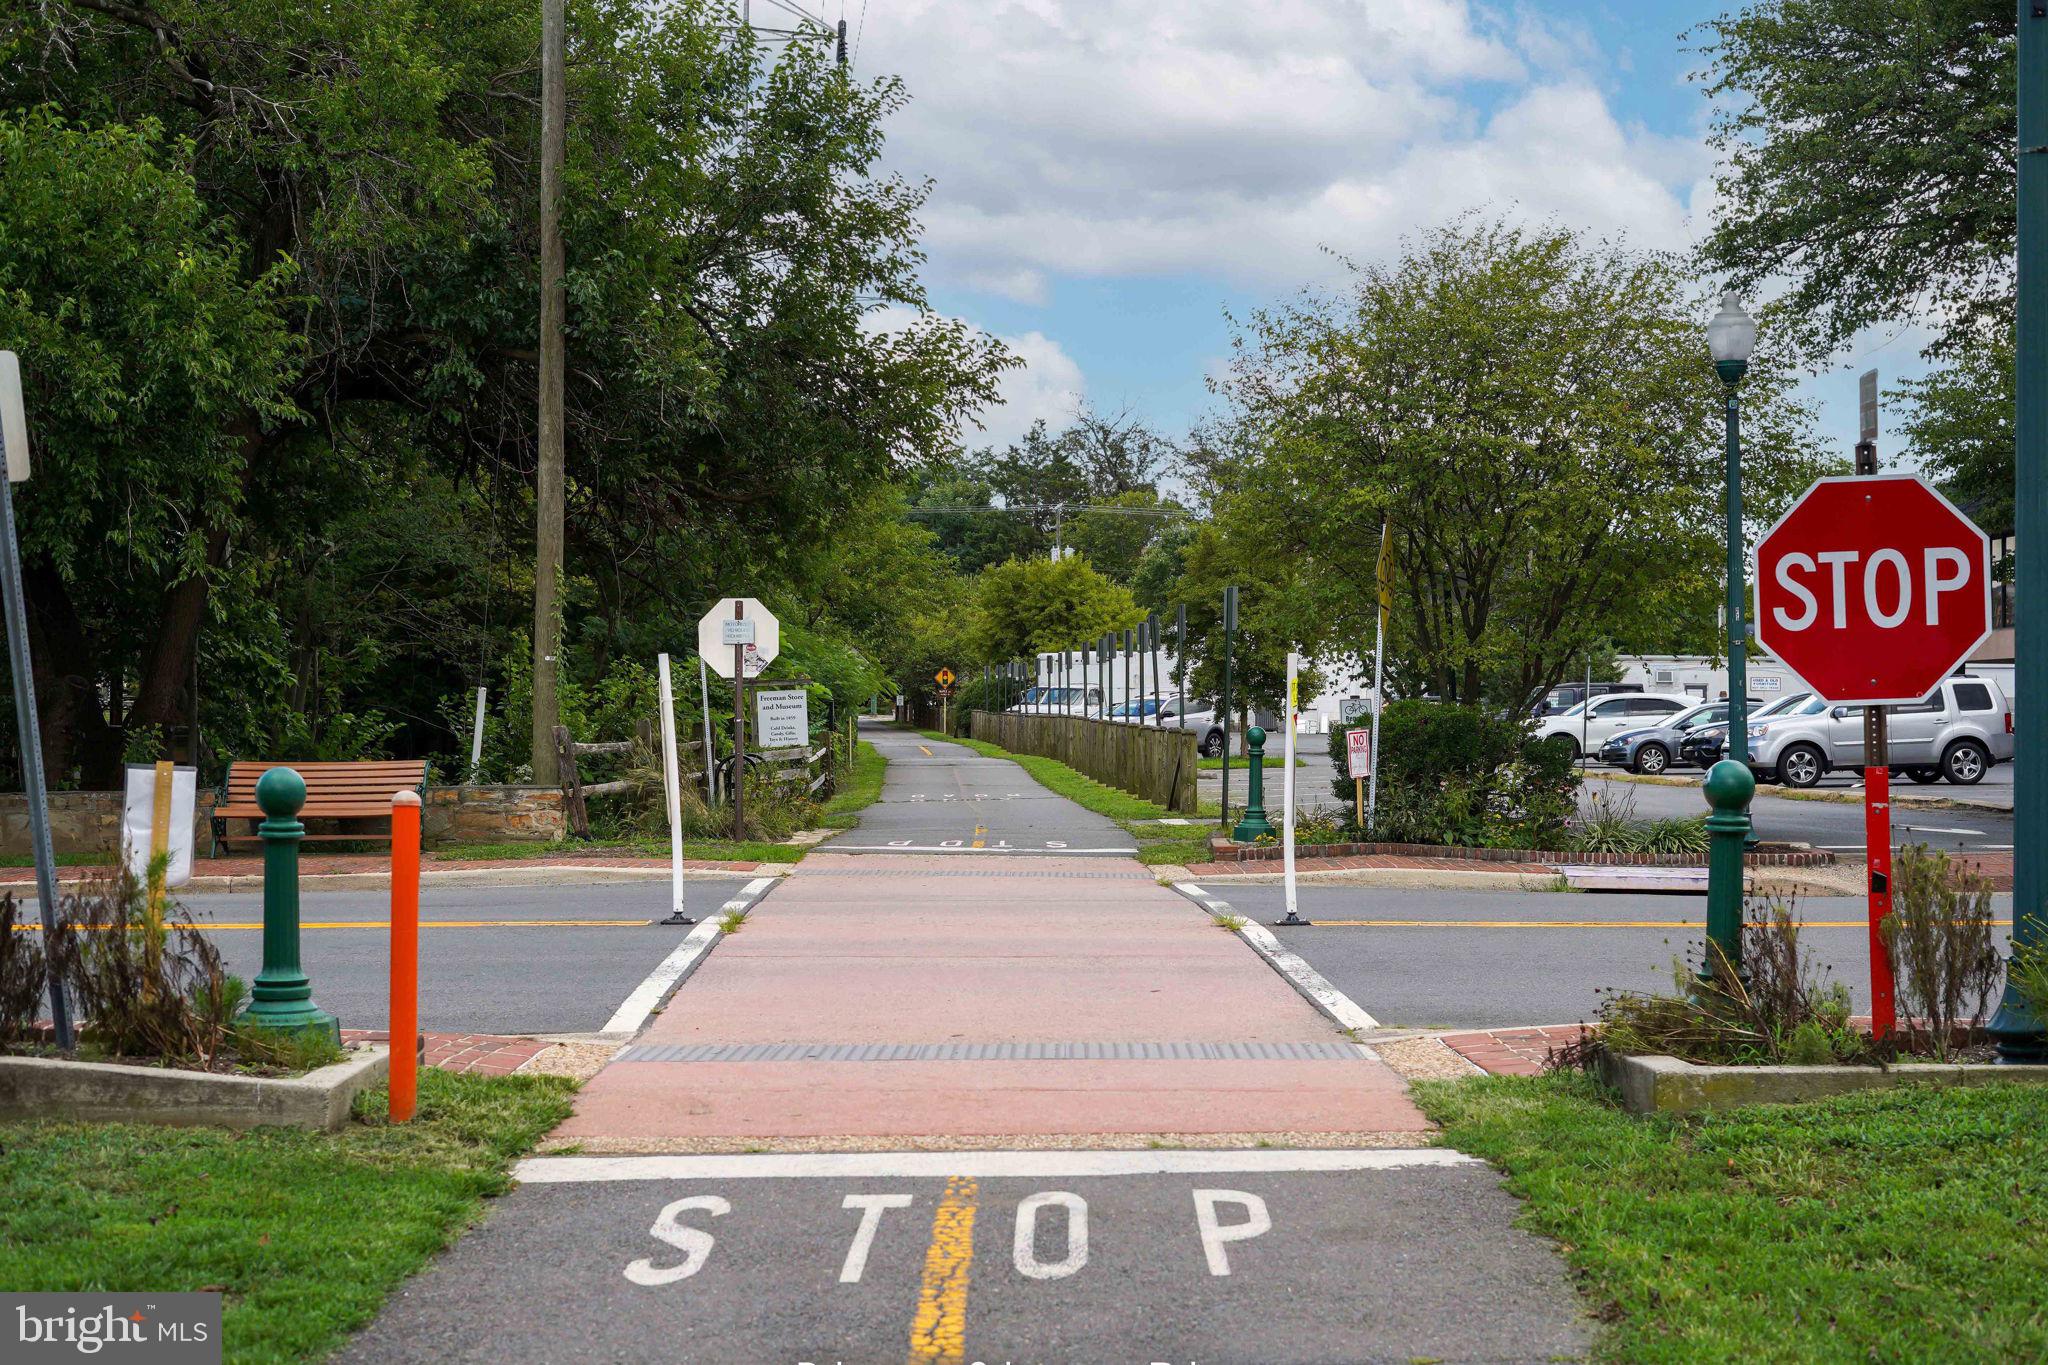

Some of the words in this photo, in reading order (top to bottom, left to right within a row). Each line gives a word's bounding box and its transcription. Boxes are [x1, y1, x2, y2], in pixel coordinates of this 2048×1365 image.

[1772, 546, 1972, 632] STOP
[787, 693, 804, 701] Store
[1353, 734, 1365, 746] NO
[1351, 745, 1367, 754] PARKING
[887, 839, 1068, 848] STOP
[623, 1188, 1273, 1286] STOP
